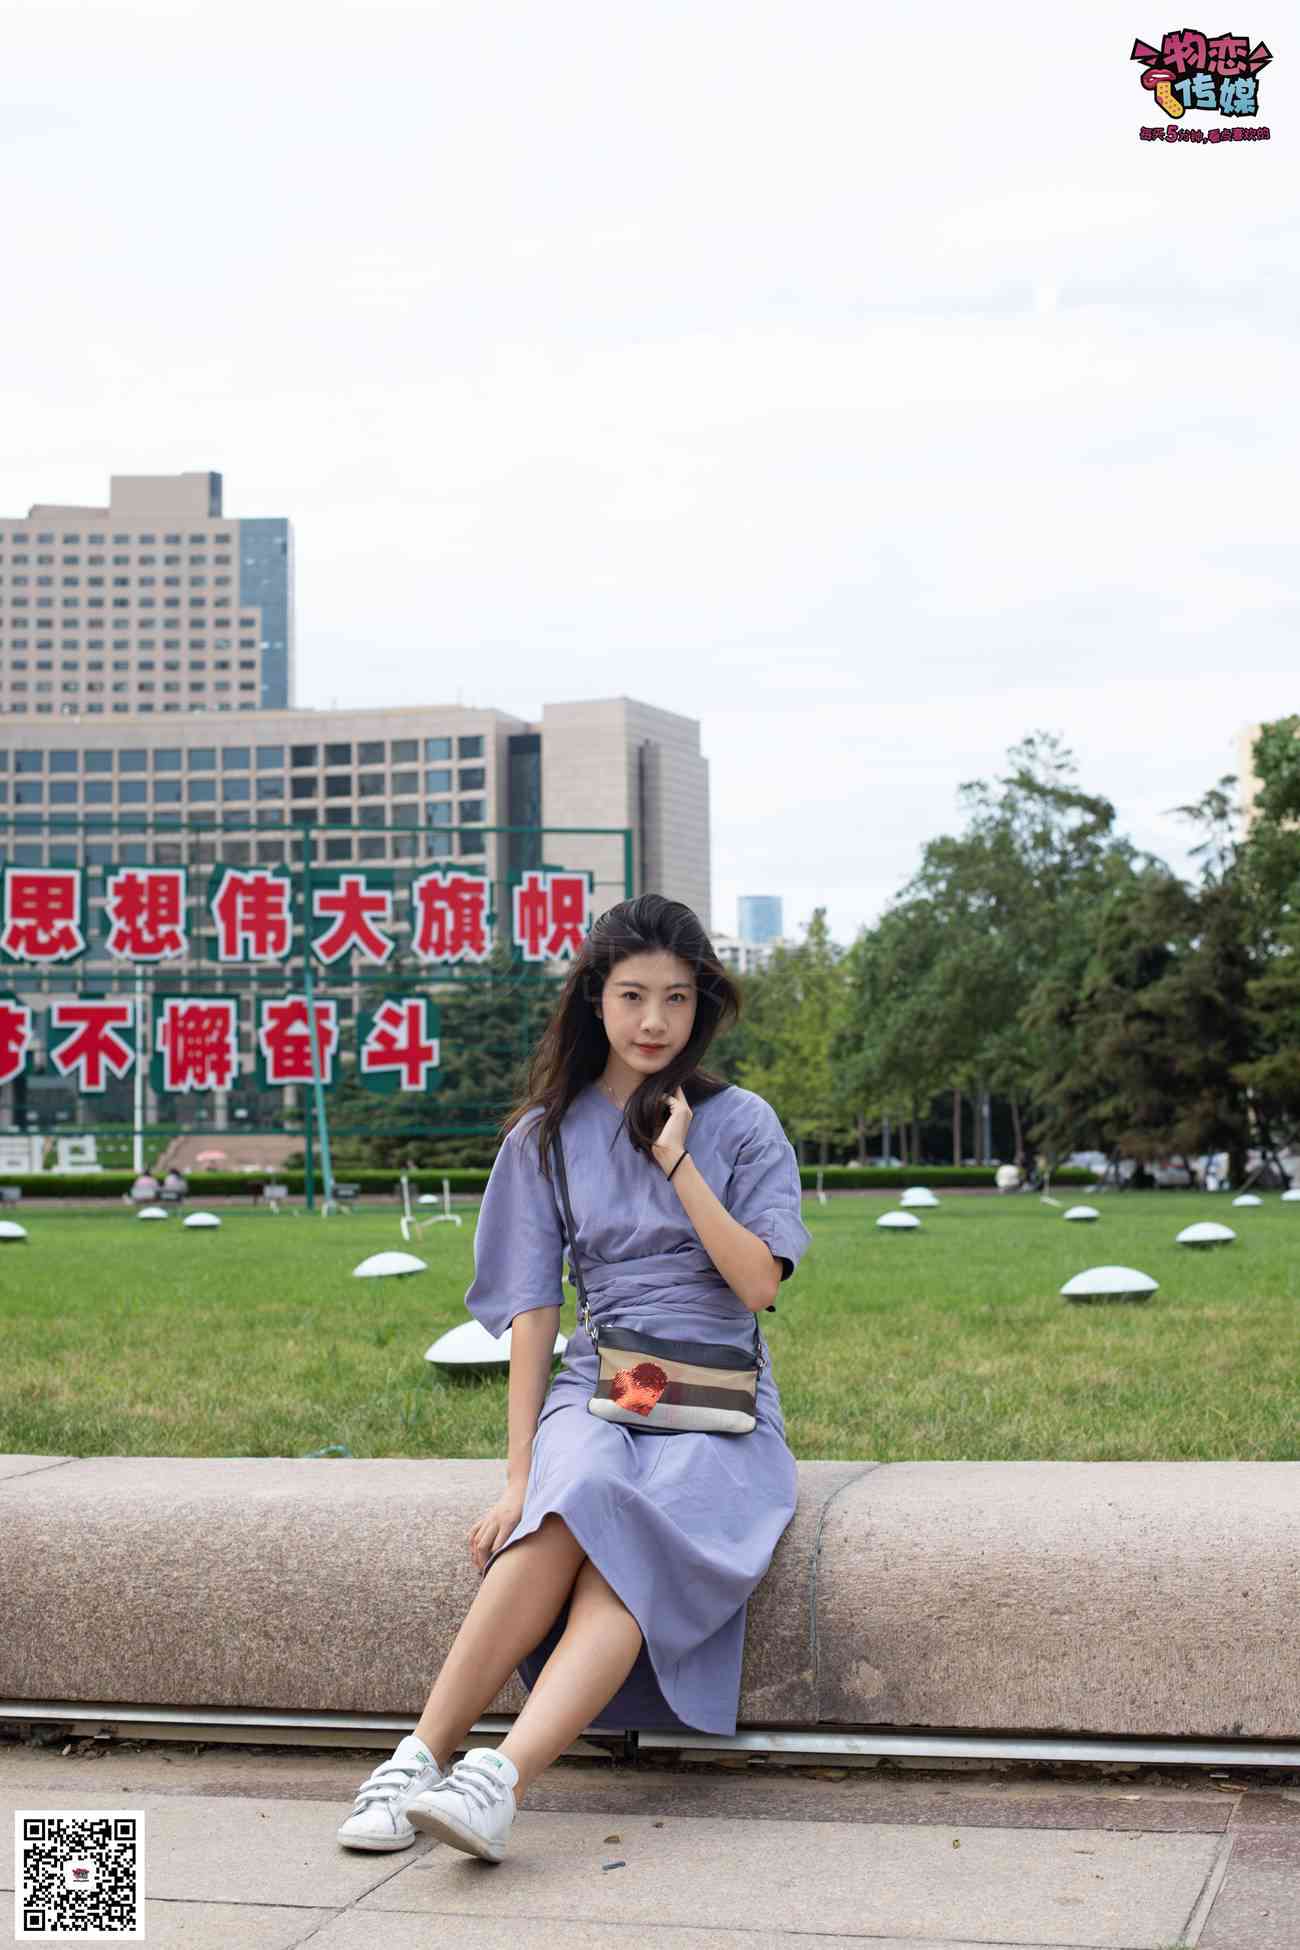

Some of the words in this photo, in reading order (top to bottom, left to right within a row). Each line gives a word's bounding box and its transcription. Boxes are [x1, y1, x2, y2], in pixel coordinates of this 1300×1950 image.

[1, 866, 587, 965] 思想伟大旗帜
